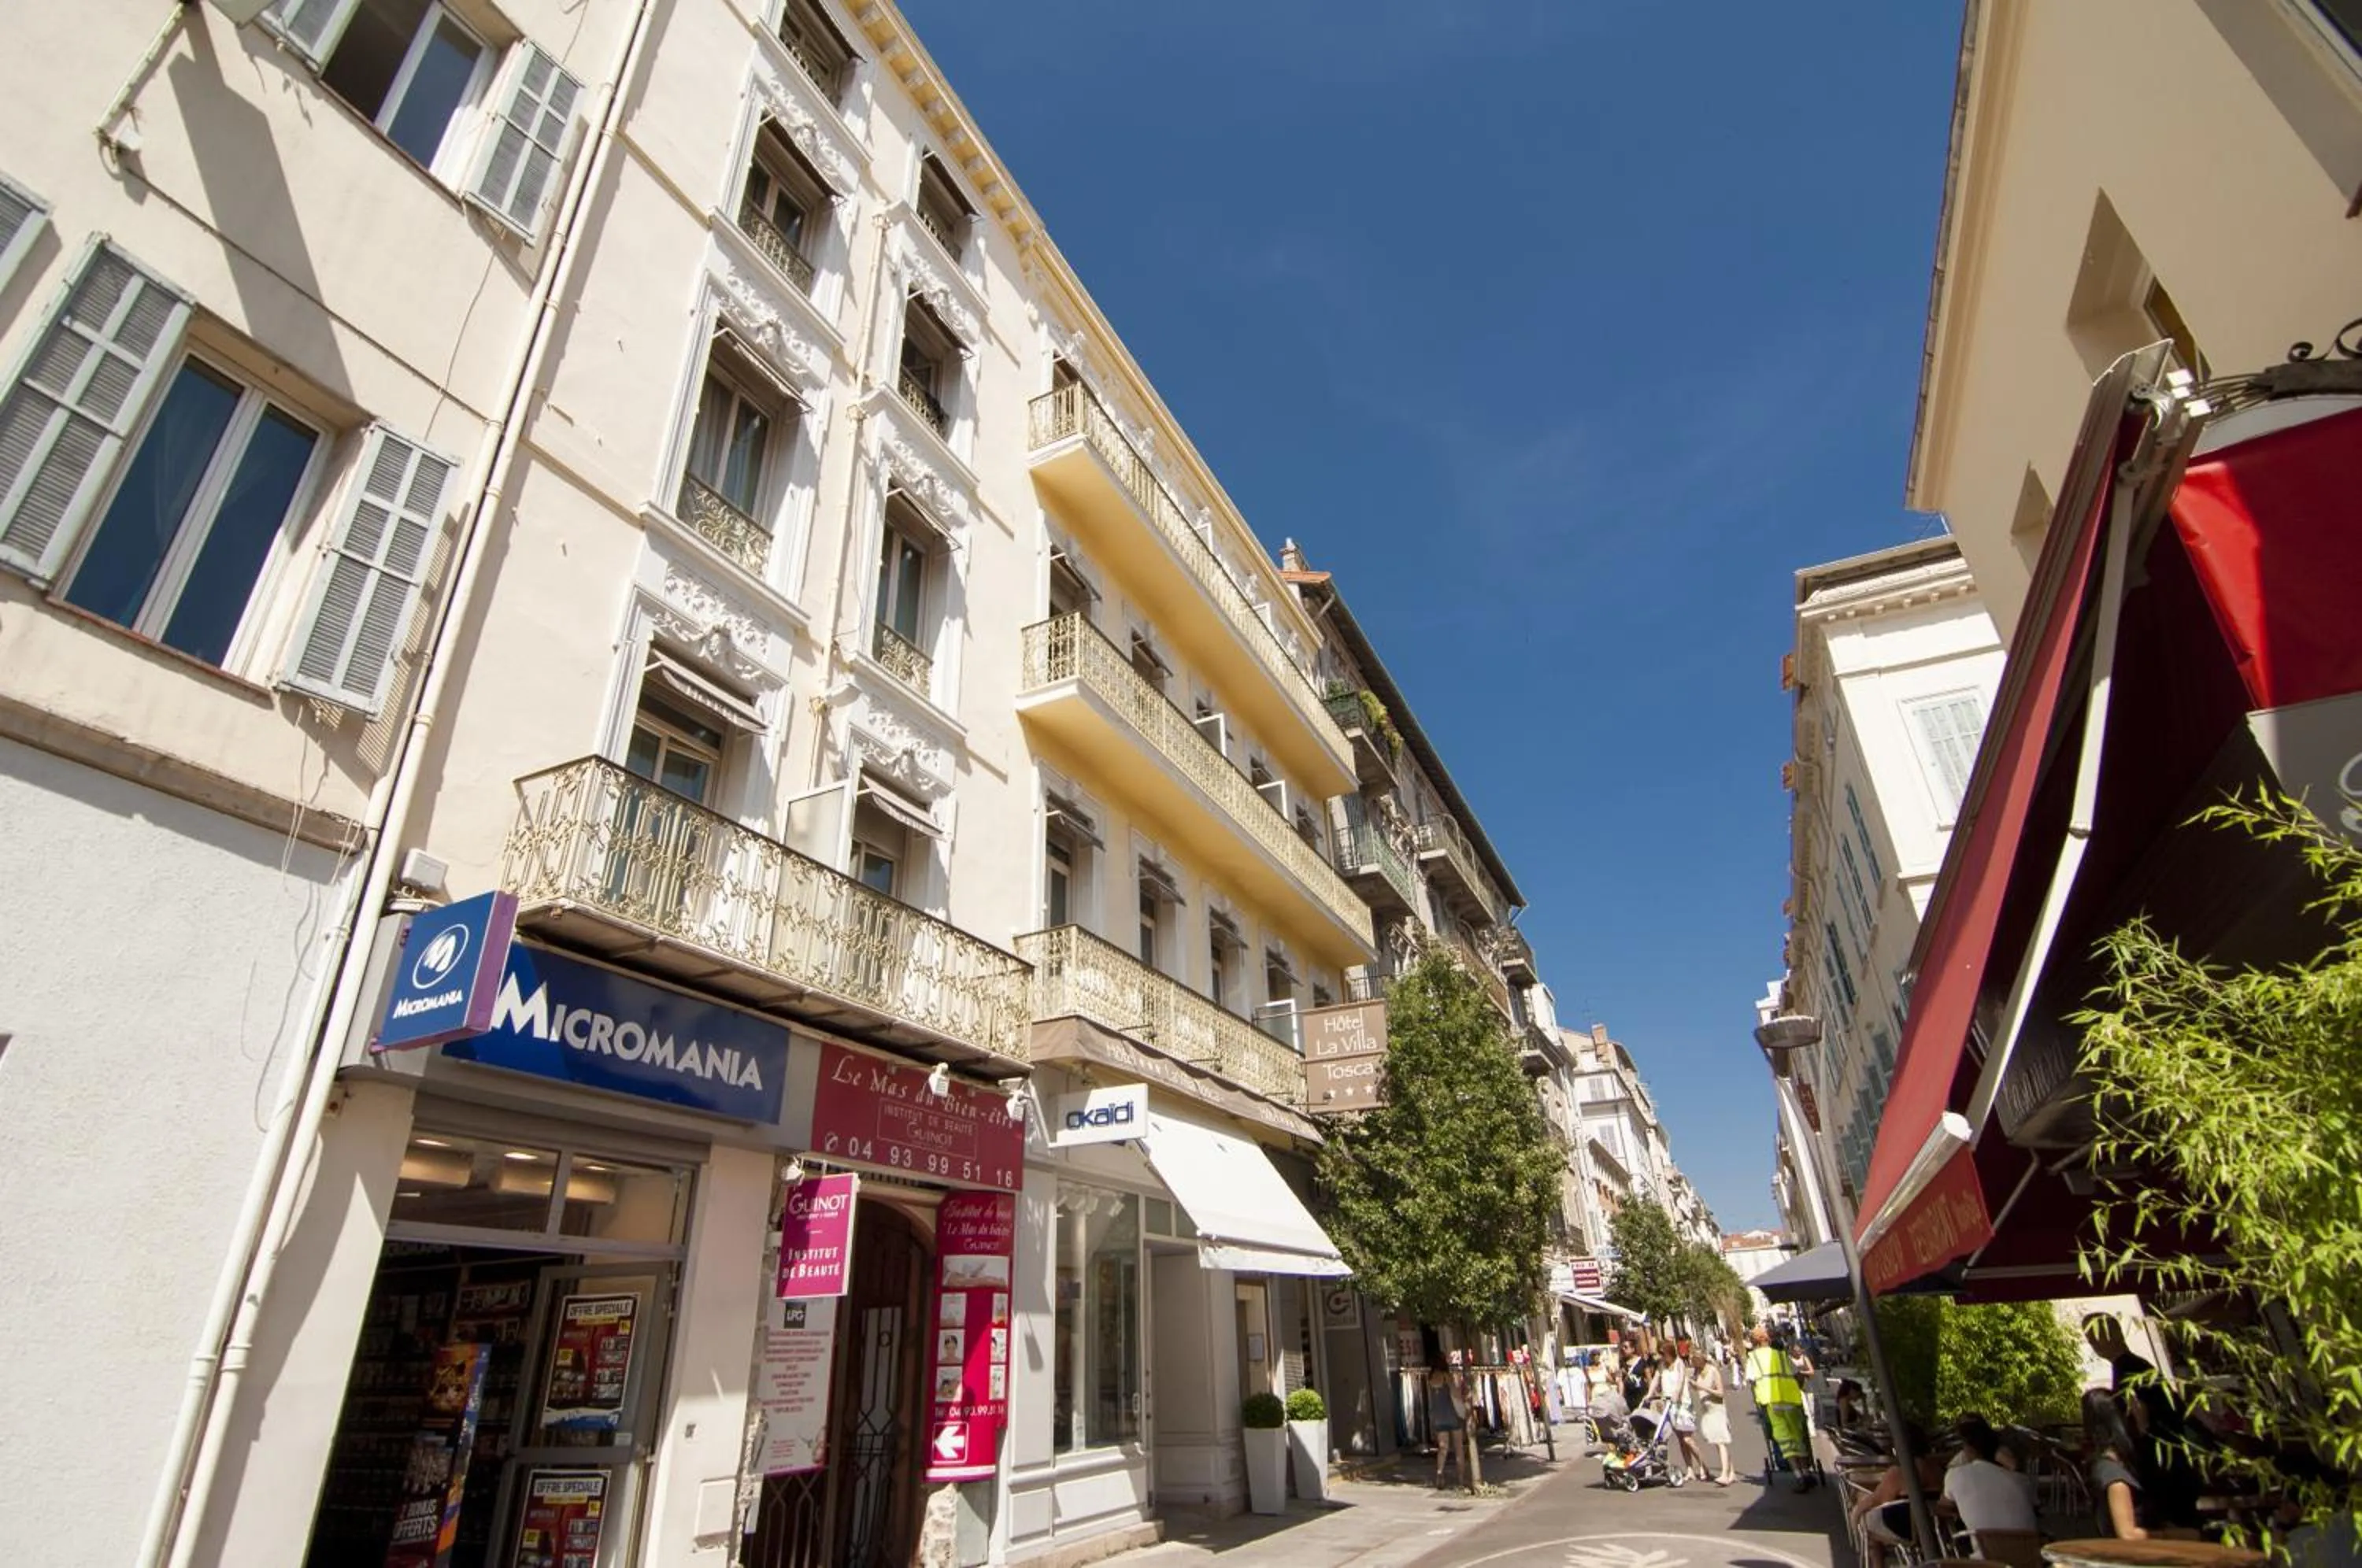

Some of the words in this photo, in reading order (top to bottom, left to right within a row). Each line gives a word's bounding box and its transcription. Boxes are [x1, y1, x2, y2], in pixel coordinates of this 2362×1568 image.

[393, 989, 463, 1019] MICROMANIA
[491, 972, 763, 1091] MICROMANIA
[1324, 1008, 1363, 1034] Hôtel
[1316, 1039, 1338, 1055] La
[1340, 1028, 1377, 1052] Villa
[831, 1055, 861, 1085] Le
[869, 1068, 906, 1098] Mas
[915, 1079, 935, 1106] du
[1323, 1062, 1374, 1080] Tosca
[884, 1104, 923, 1126] INSTITUT
[928, 1114, 938, 1126] DE
[1067, 1100, 1134, 1130] okaïdi
[907, 1122, 953, 1147] GUINOT
[848, 1137, 872, 1159] 04
[890, 1146, 912, 1168] 93
[927, 1154, 950, 1174] 99
[996, 1168, 1013, 1188] 16
[789, 1193, 849, 1215] GUINOT
[788, 1247, 839, 1261] INSTITUT
[781, 1266, 796, 1279] DE
[799, 1262, 840, 1278] BEAUTÉ
